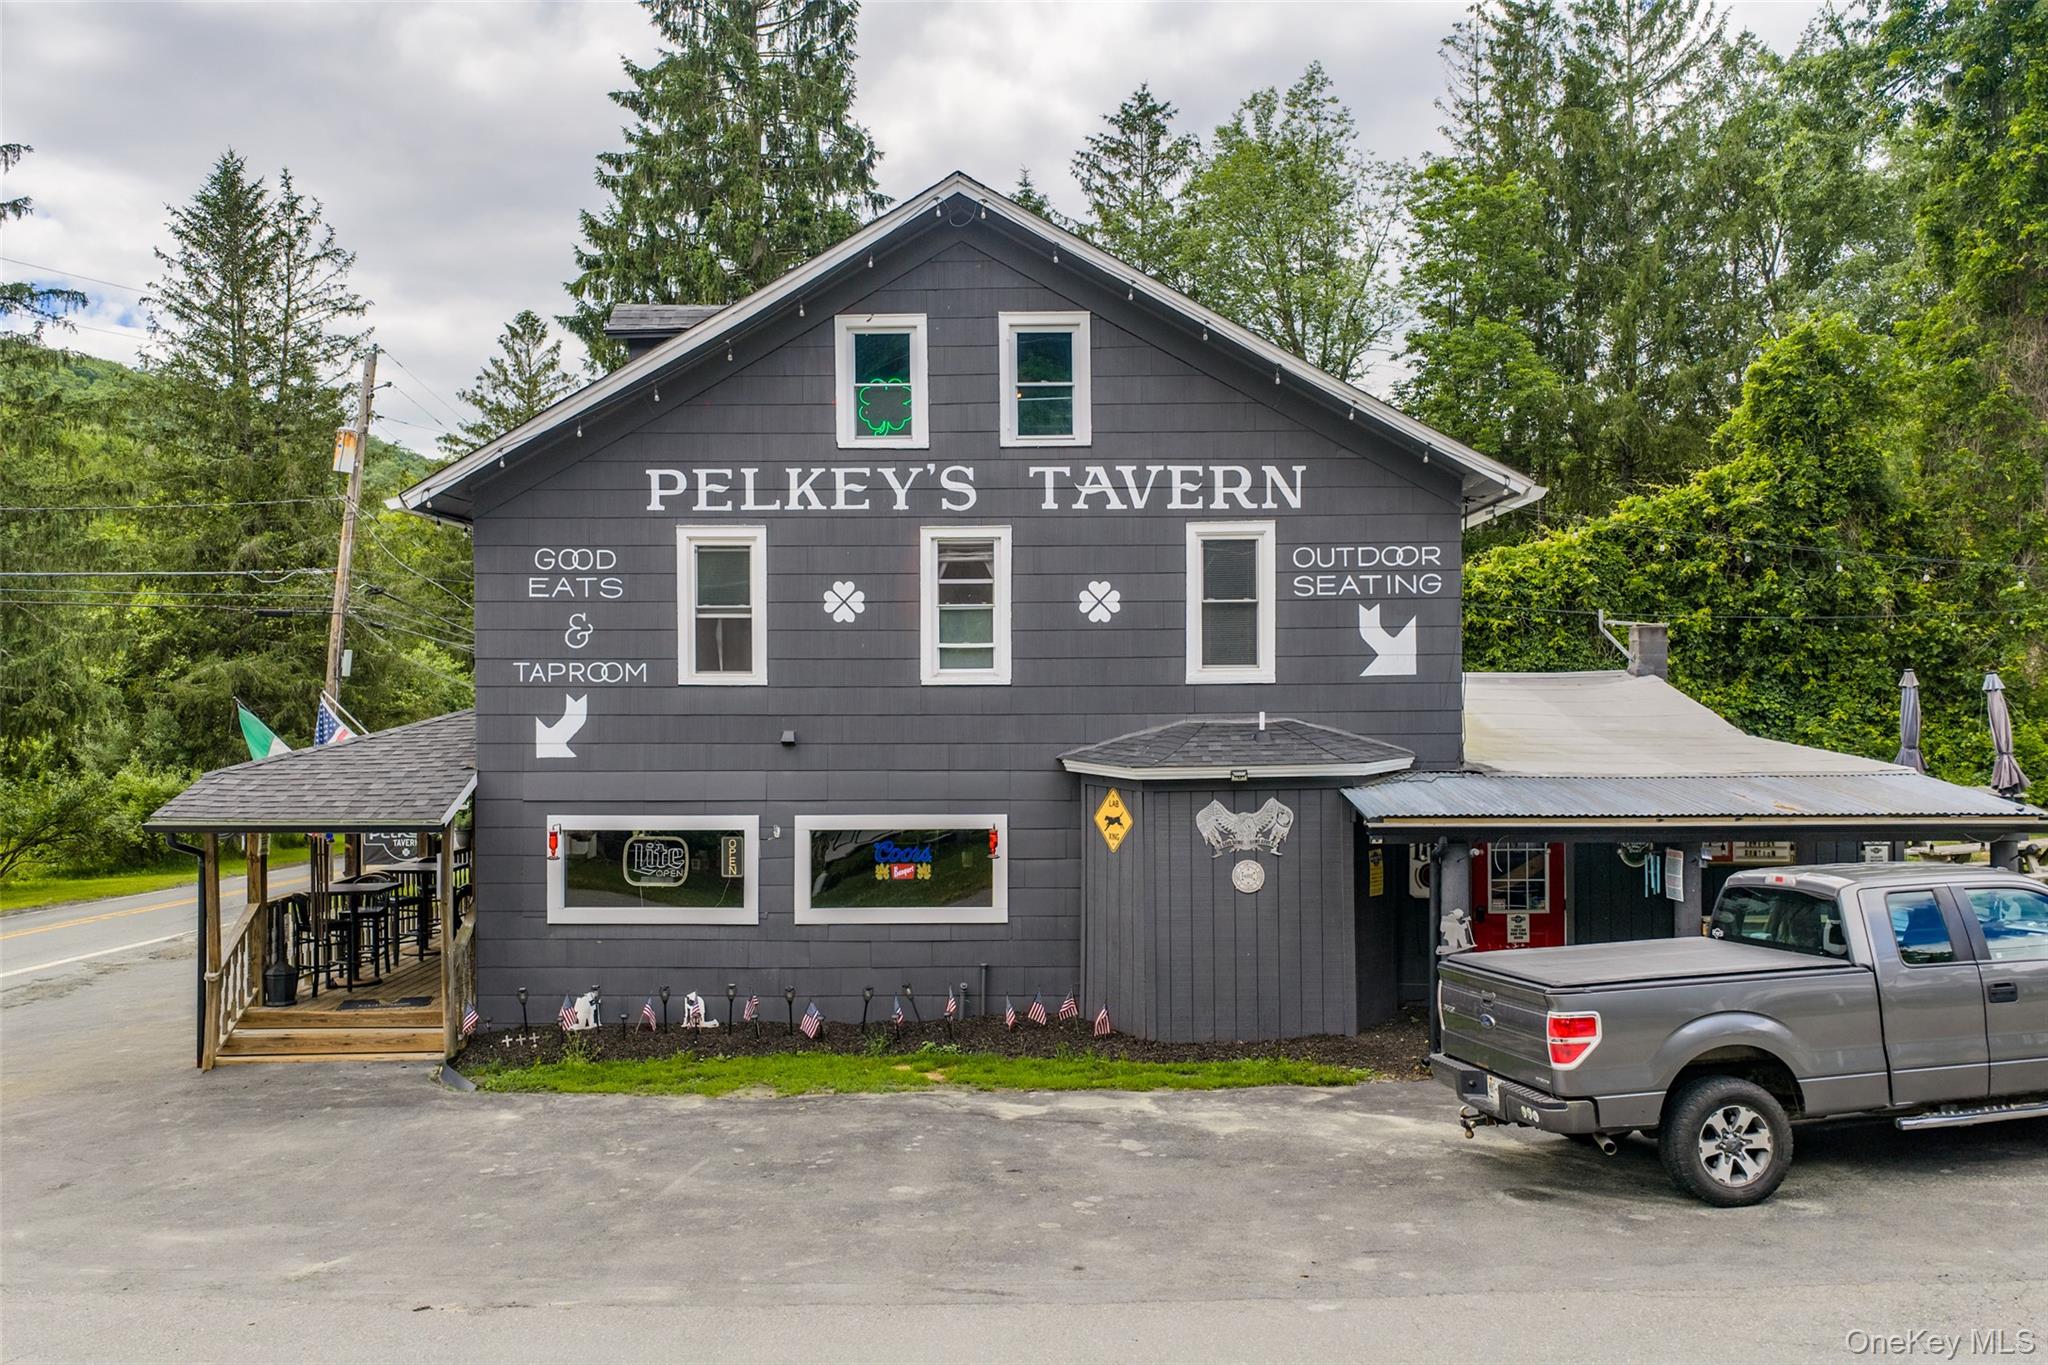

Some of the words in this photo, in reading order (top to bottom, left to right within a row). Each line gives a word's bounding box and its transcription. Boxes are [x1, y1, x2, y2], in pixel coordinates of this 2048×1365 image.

[646, 463, 977, 512] PELKEY'S
[1029, 464, 1307, 510] TAVERN
[534, 547, 617, 571] GOOD
[1292, 545, 1441, 569] OUTDOOR
[528, 576, 624, 599] EATS
[1293, 573, 1442, 597] SEATING
[564, 612, 594, 649] &
[512, 661, 647, 683] TAPROOM
[1108, 799, 1120, 808] LAB
[633, 841, 686, 876] Lite
[728, 839, 737, 875] OPEN
[873, 840, 932, 863] Coors
[655, 869, 684, 877] OPEN
